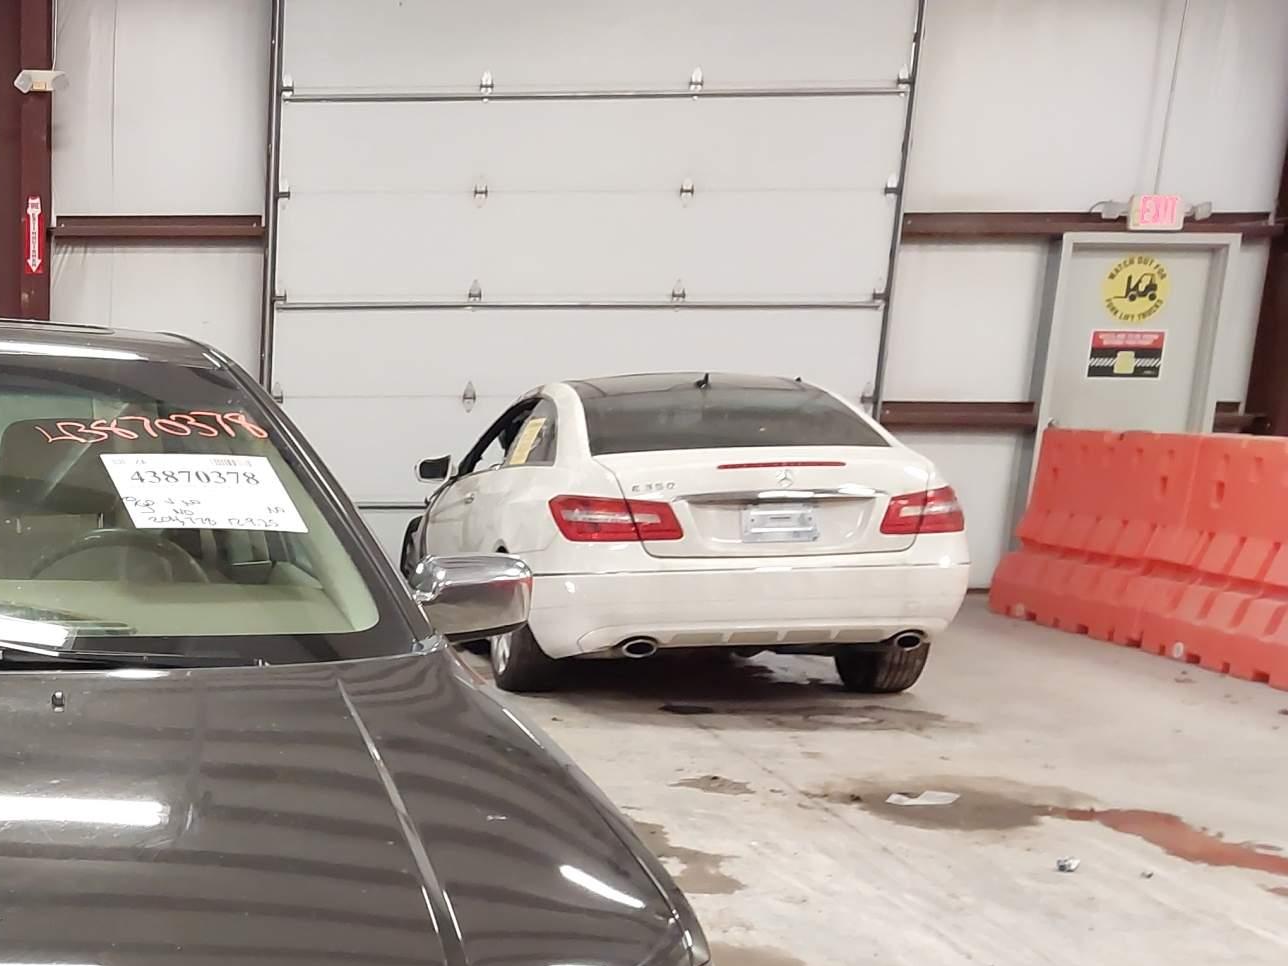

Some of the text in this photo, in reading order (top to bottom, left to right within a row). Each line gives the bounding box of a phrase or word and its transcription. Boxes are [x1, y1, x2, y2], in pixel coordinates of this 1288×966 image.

[1140, 196, 1178, 225] EXIT
[1108, 255, 1167, 280] WATCH OUT FOR
[1105, 298, 1164, 322] FORK LIFT TRUCKS
[130, 470, 260, 486] 43870378
[645, 482, 675, 491] 350
